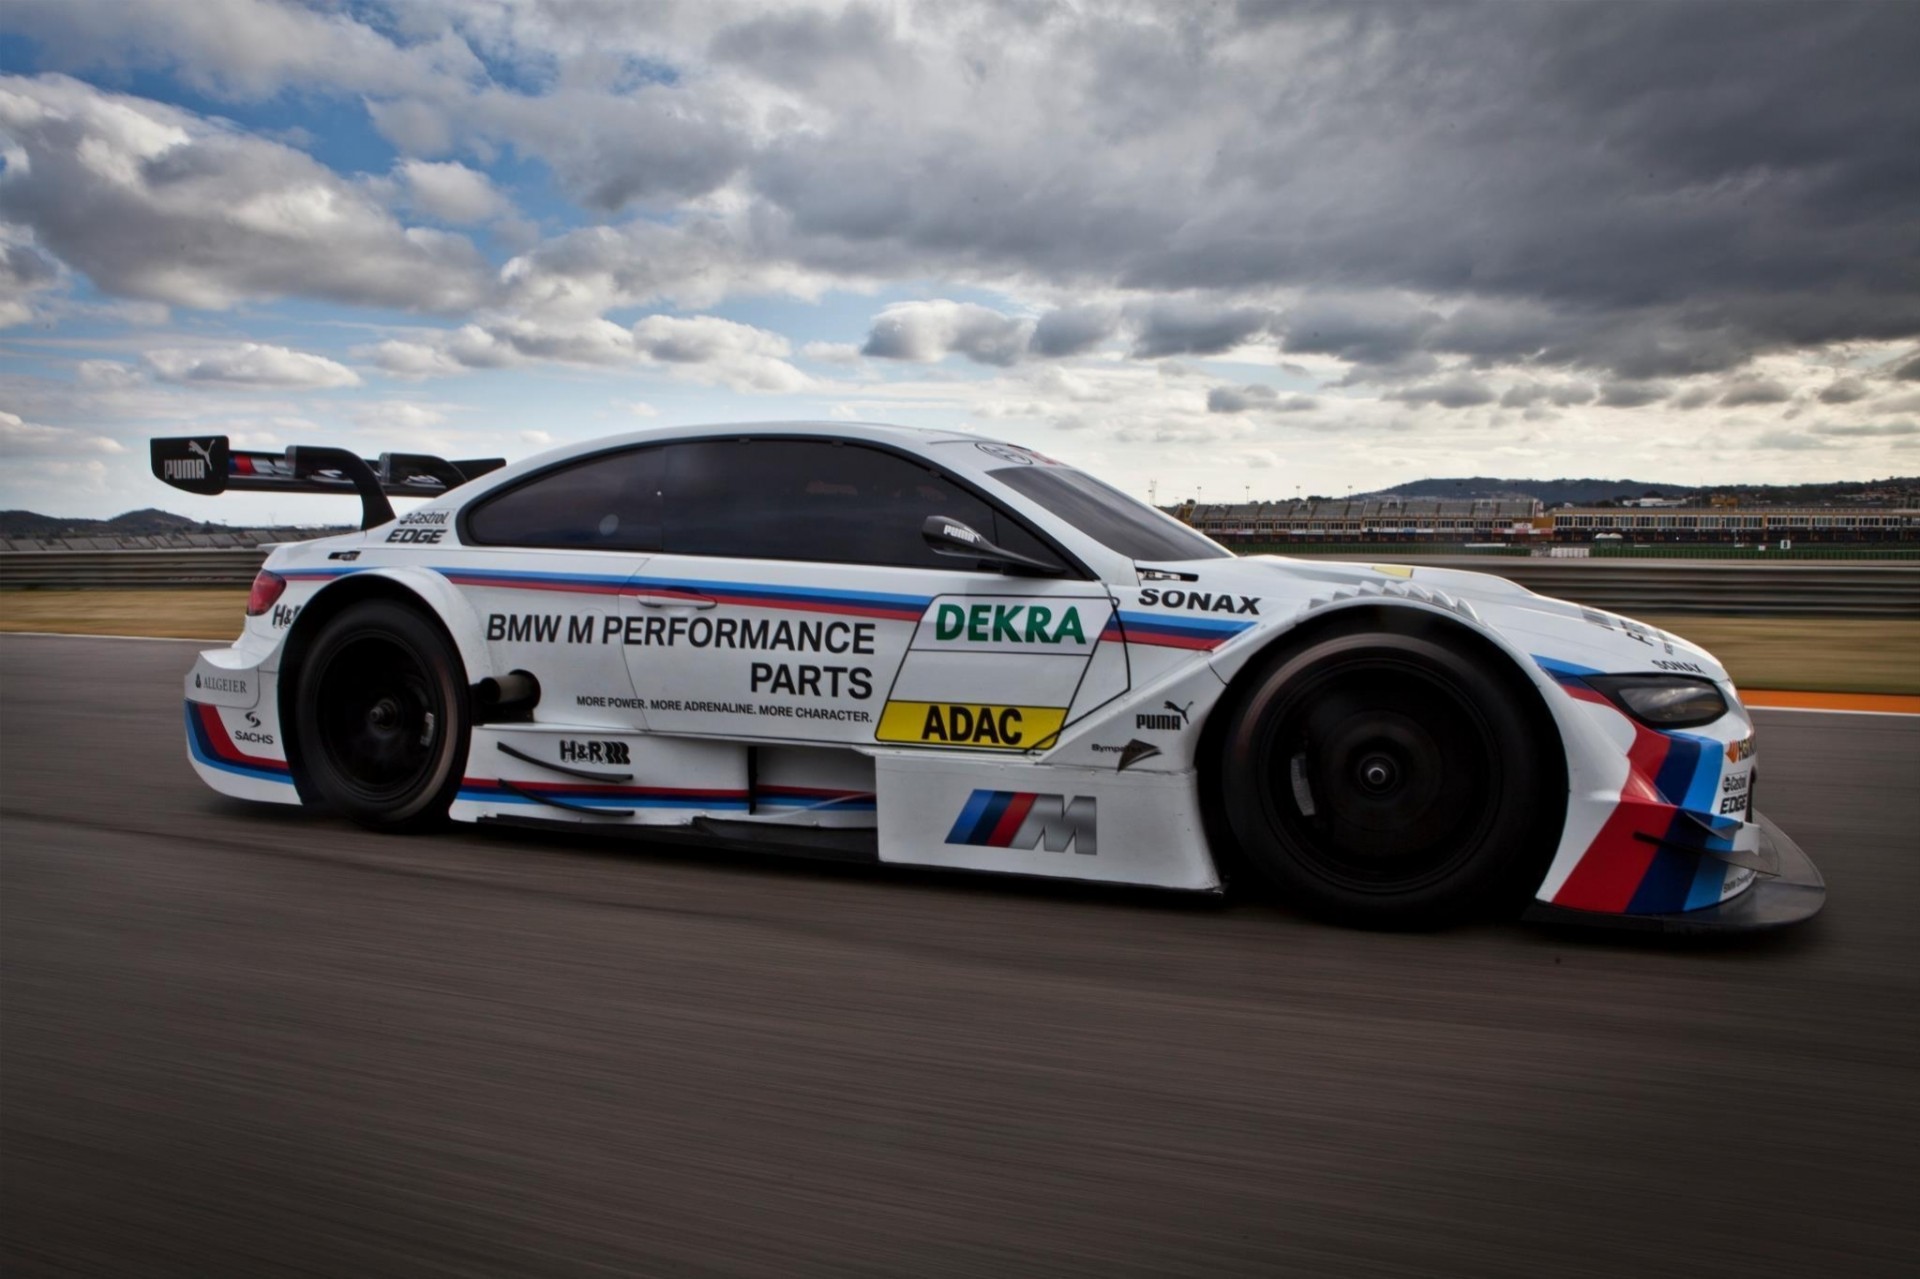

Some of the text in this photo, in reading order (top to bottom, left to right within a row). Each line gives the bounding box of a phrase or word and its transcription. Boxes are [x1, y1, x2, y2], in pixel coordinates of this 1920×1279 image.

[164, 459, 205, 480] PUMA
[409, 511, 449, 524] Castrol
[385, 528, 448, 544] EDGE
[943, 524, 975, 543] PUMA
[1138, 588, 1262, 615] SONAX
[486, 613, 877, 655] BMW M PERFORMANCE
[935, 603, 1087, 645] DEKRA
[1651, 659, 1706, 675] SONAX
[203, 676, 248, 694] ALLGEIER
[750, 662, 873, 700] PARTS
[577, 695, 873, 723] MORE POWER. MORE ADRENALINE. MORE CHARACTER.
[921, 705, 1023, 745] ADAC
[1136, 713, 1181, 730] PUMA
[235, 730, 274, 745] SACHS
[1005, 792, 1097, 855] M
